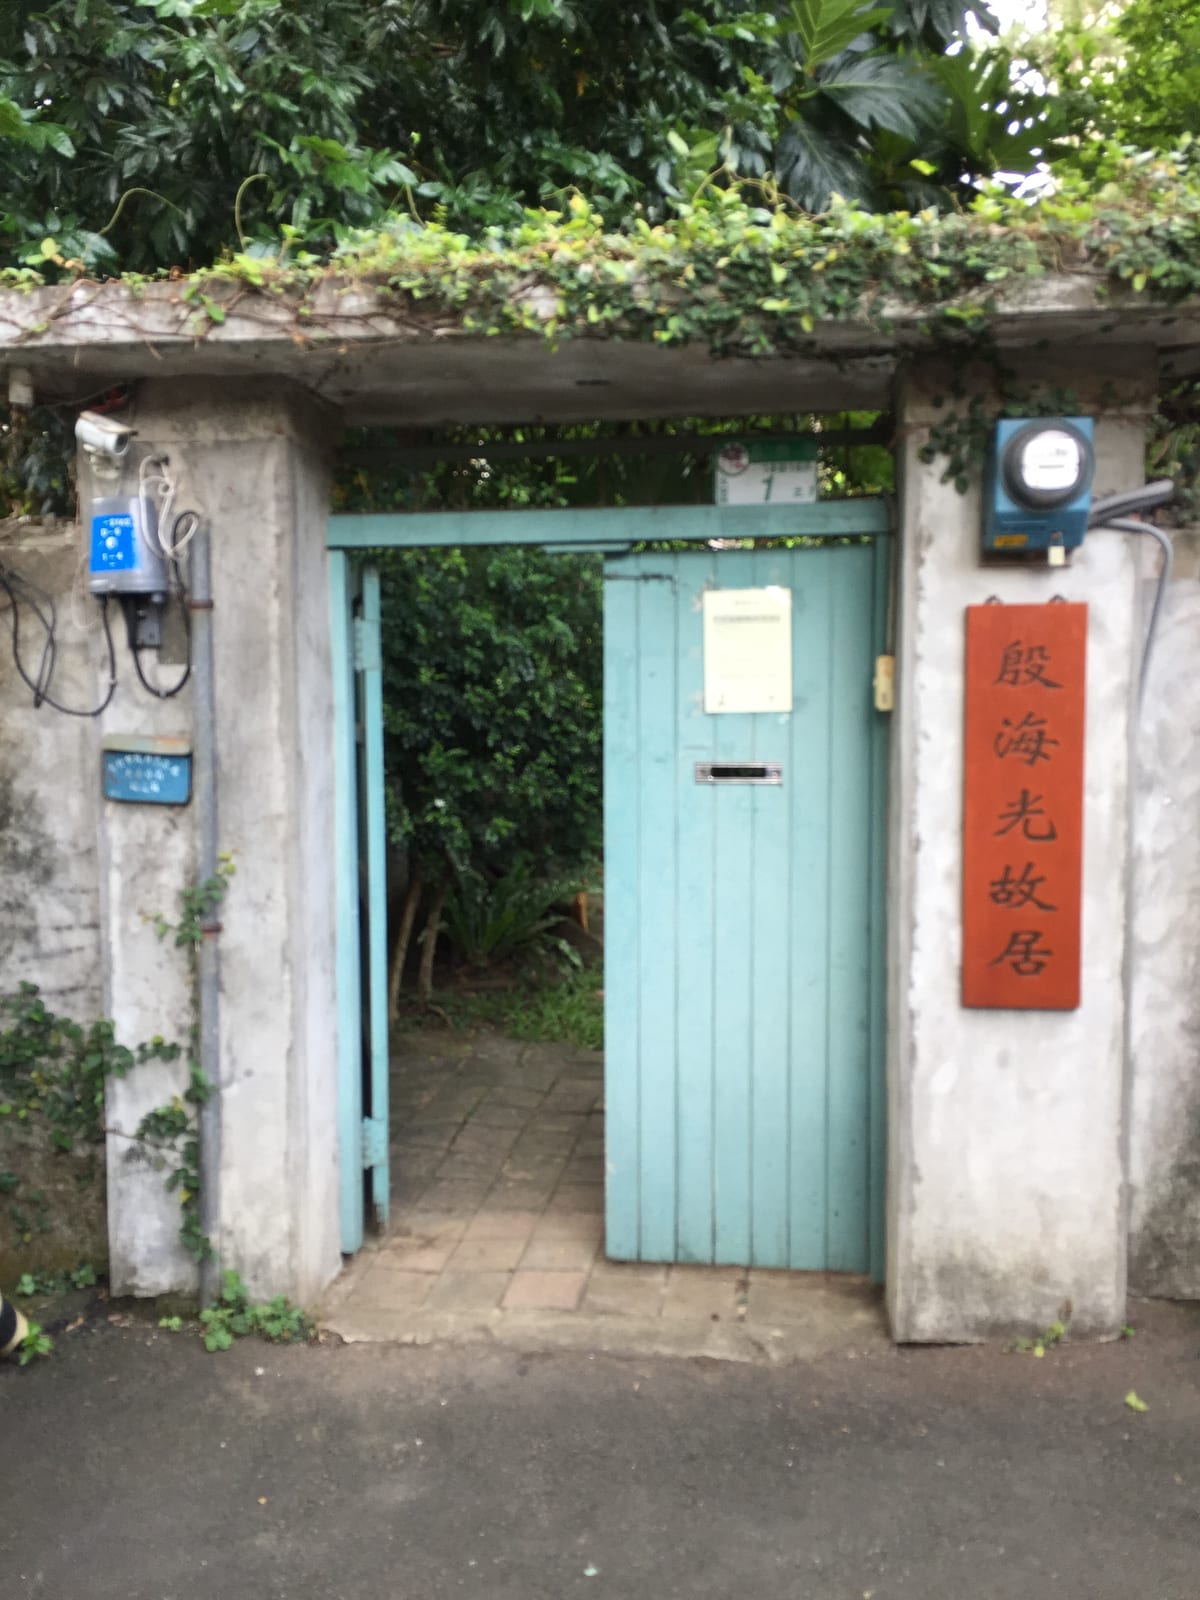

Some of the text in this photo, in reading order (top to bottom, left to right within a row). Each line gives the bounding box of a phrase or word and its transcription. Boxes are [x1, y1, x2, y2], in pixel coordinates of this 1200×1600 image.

[988, 640, 1063, 976] 殷海光故居
